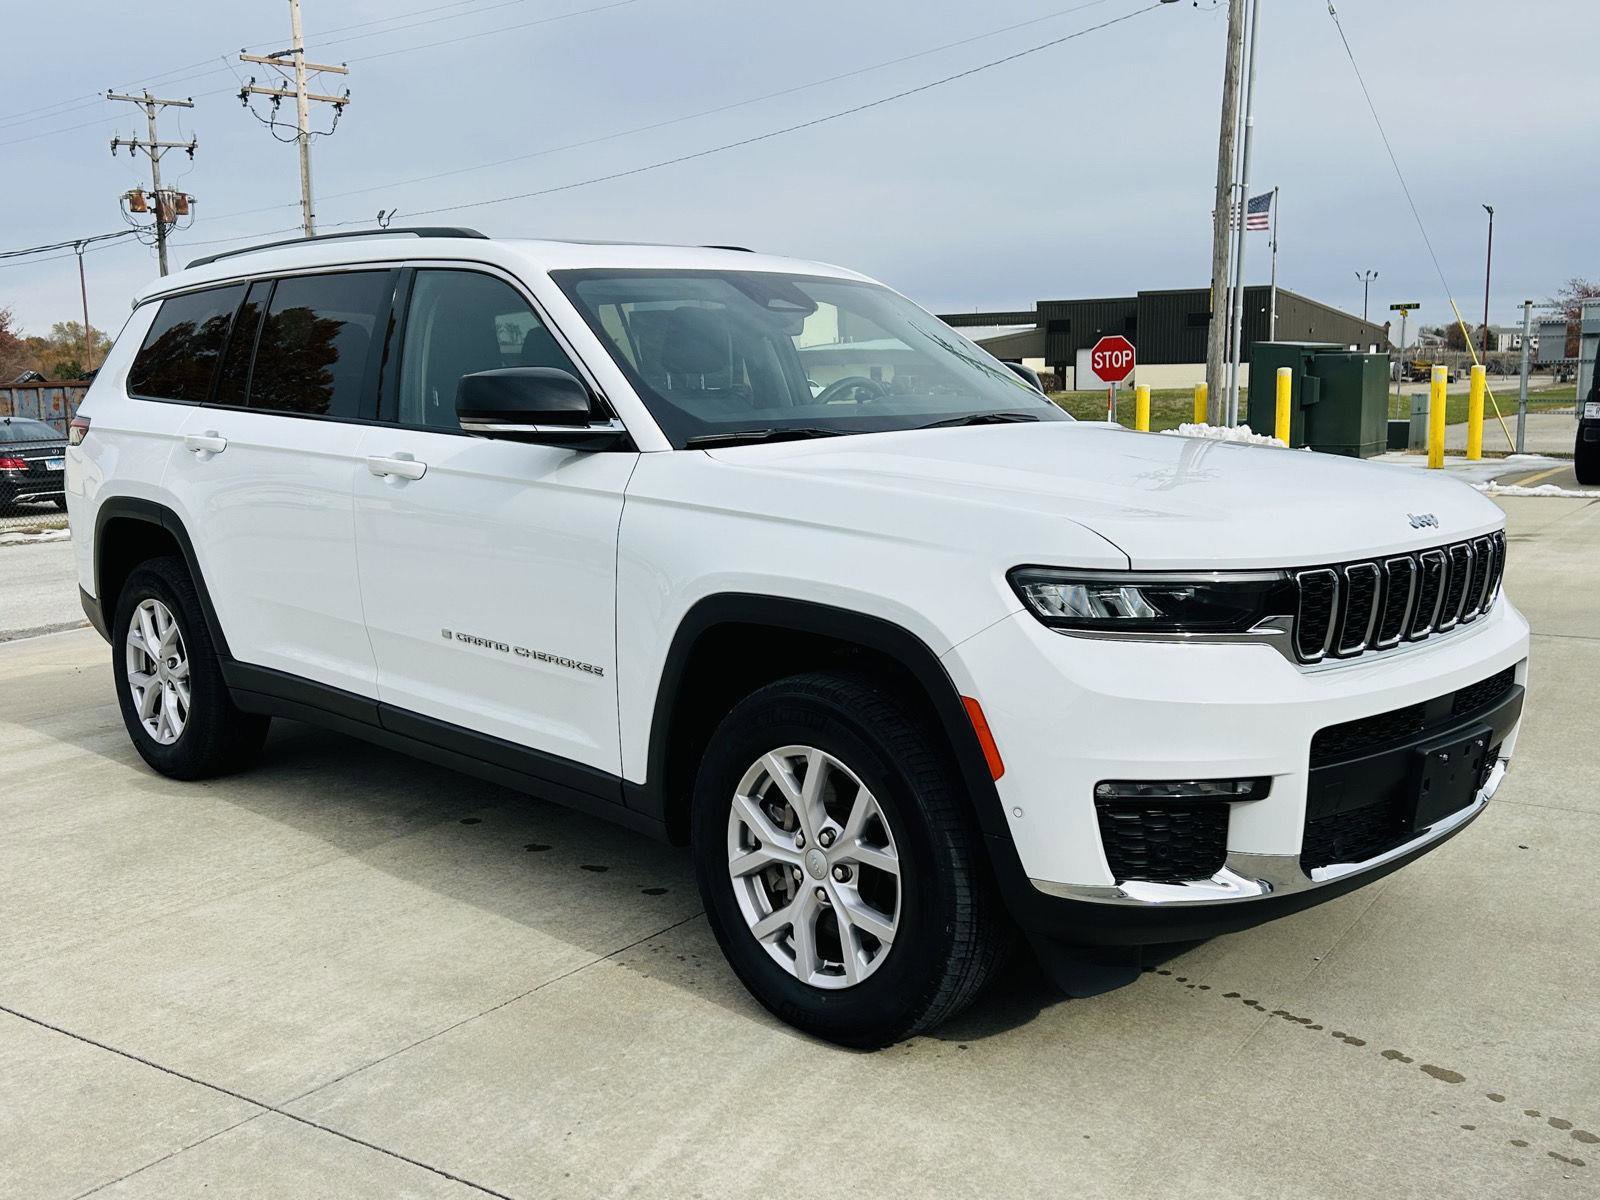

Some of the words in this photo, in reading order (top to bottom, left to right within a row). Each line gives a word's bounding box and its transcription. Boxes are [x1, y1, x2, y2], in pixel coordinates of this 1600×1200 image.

[1094, 350, 1132, 369] STOP
[1407, 513, 1439, 529] Jeep
[456, 632, 510, 653] GRAND
[513, 646, 604, 677] CHEROKEE
